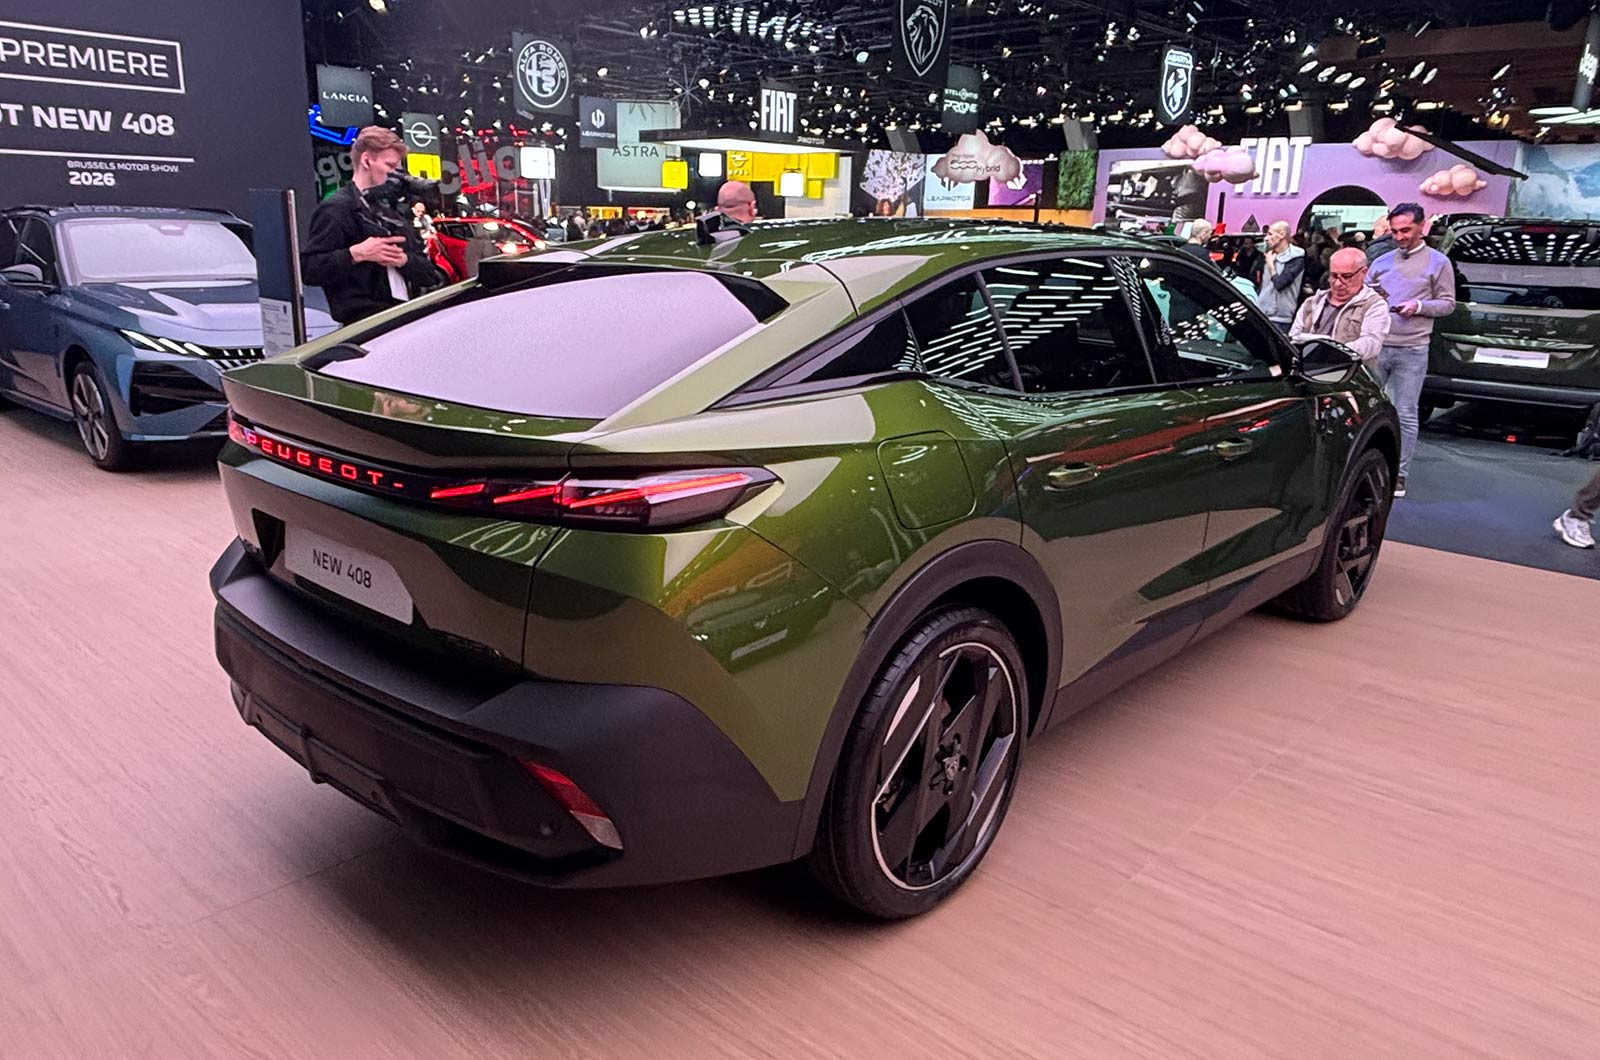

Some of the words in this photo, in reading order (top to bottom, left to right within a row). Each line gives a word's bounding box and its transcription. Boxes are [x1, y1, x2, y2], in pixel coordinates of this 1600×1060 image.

[0, 38, 170, 78] PREMIERE
[519, 46, 536, 72] ALFA
[539, 44, 566, 79] ROMEO
[322, 91, 368, 103] LANCIA
[761, 88, 797, 133] FIAT
[0, 103, 24, 126] T
[31, 105, 112, 132] NEW
[121, 112, 175, 136] 408
[67, 160, 116, 170] BRUSSELS
[117, 163, 150, 172] MOTOR
[150, 164, 179, 173] SHOW
[612, 145, 659, 158] ASTRA
[68, 171, 116, 187] 2026
[246, 432, 384, 486] PEUGEOT
[312, 549, 342, 576] NEW
[346, 564, 372, 589] 408
